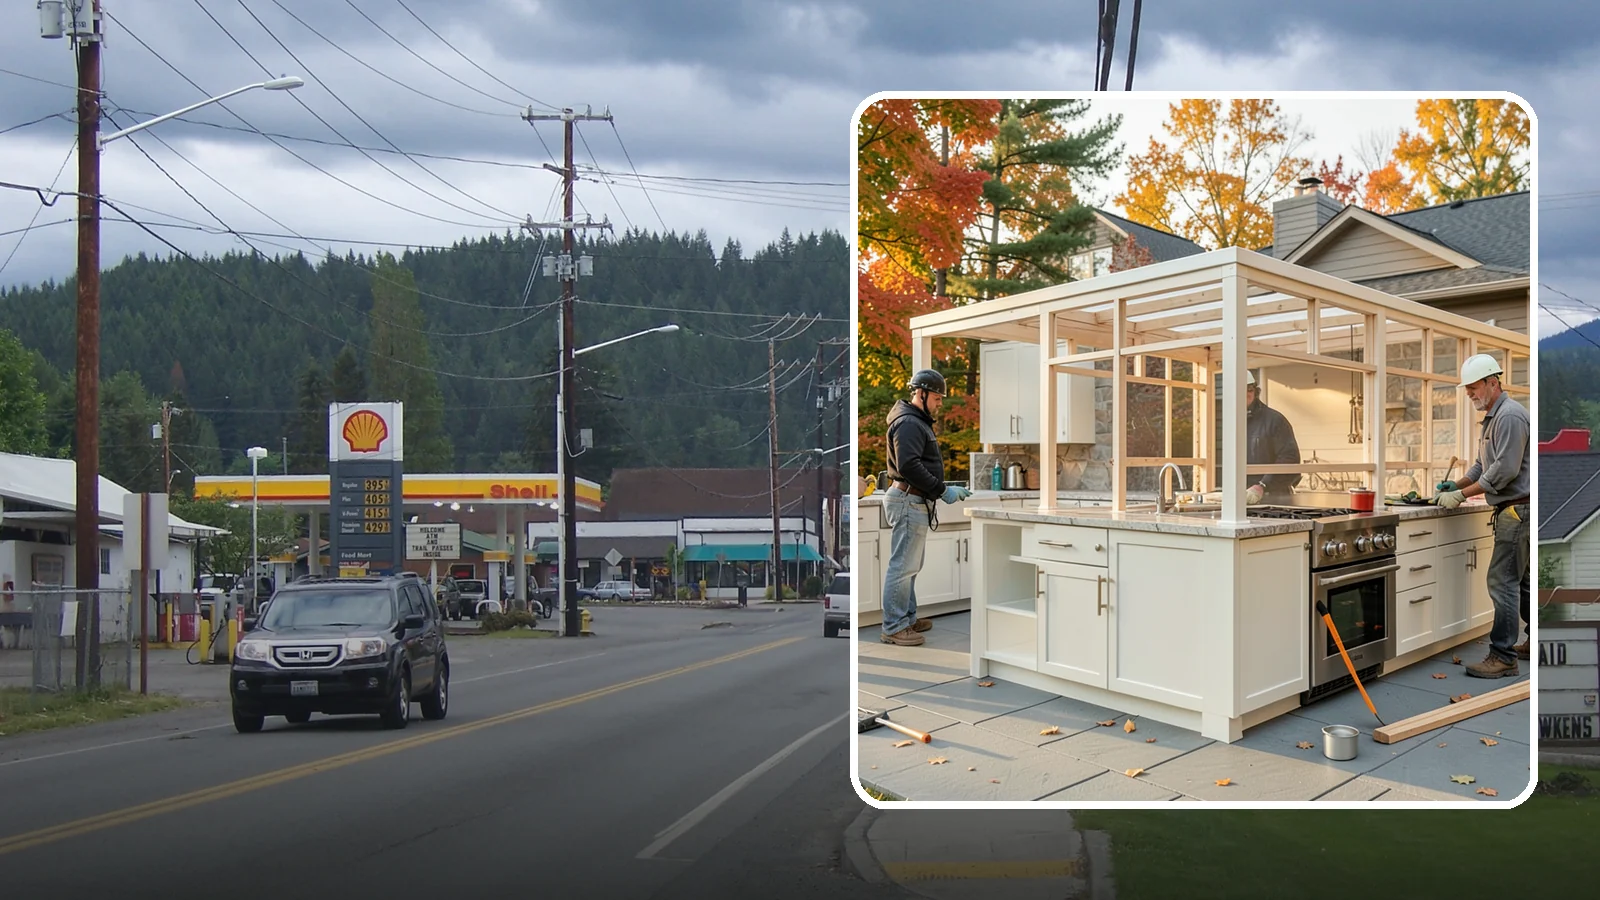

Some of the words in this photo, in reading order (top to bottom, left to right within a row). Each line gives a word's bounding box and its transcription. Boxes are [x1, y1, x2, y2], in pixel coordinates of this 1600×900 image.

[366, 480, 383, 490] 395
[490, 484, 547, 499] Shell
[366, 494, 383, 504] 405
[366, 508, 383, 518] 415
[366, 522, 383, 532] 429
